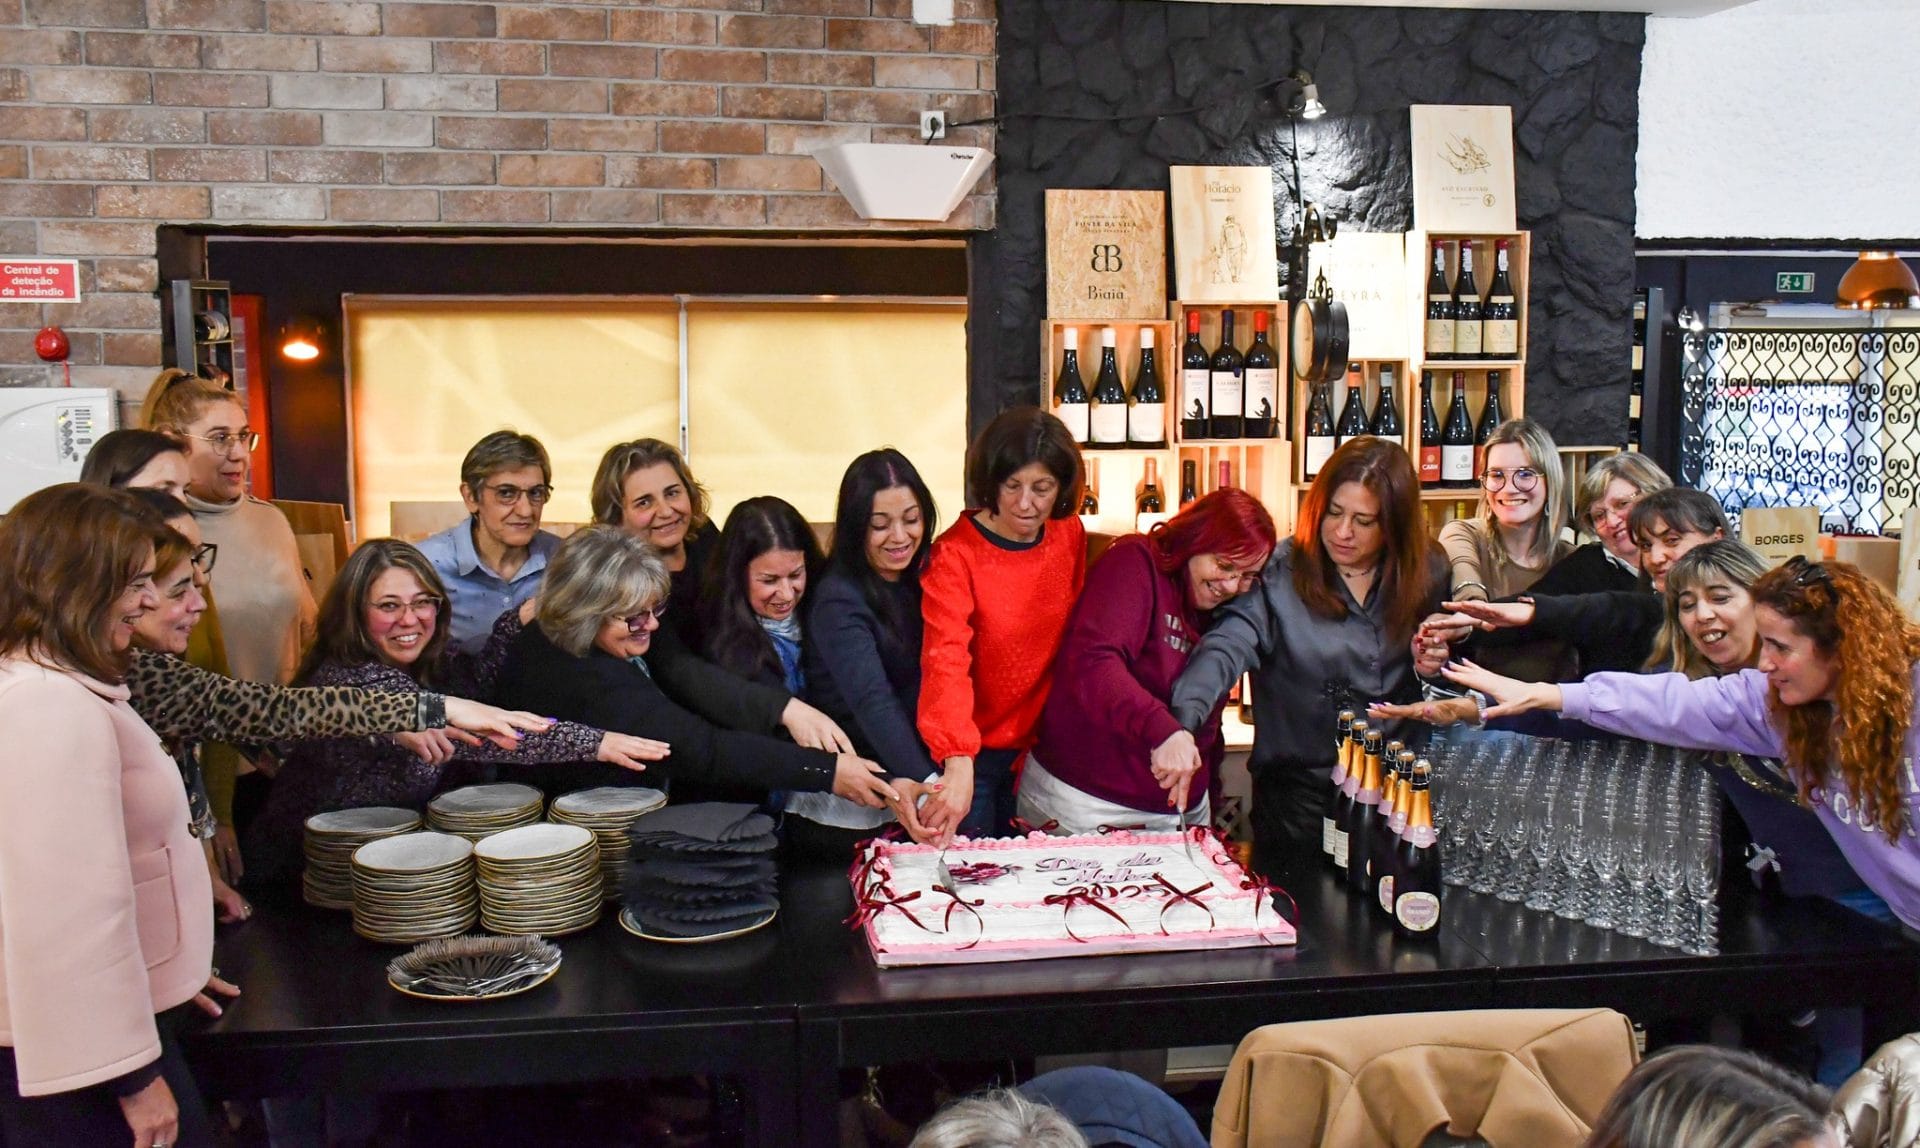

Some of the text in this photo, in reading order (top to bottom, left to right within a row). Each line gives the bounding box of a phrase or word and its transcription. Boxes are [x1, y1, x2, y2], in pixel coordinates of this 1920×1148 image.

[3, 265, 59, 275] Central de
[11, 276, 53, 288] deteção
[1, 287, 65, 296] de incêndio
[1088, 285, 1125, 300] Biaia
[1754, 534, 1805, 546] BORGES
[1035, 852, 1164, 873] Dia da
